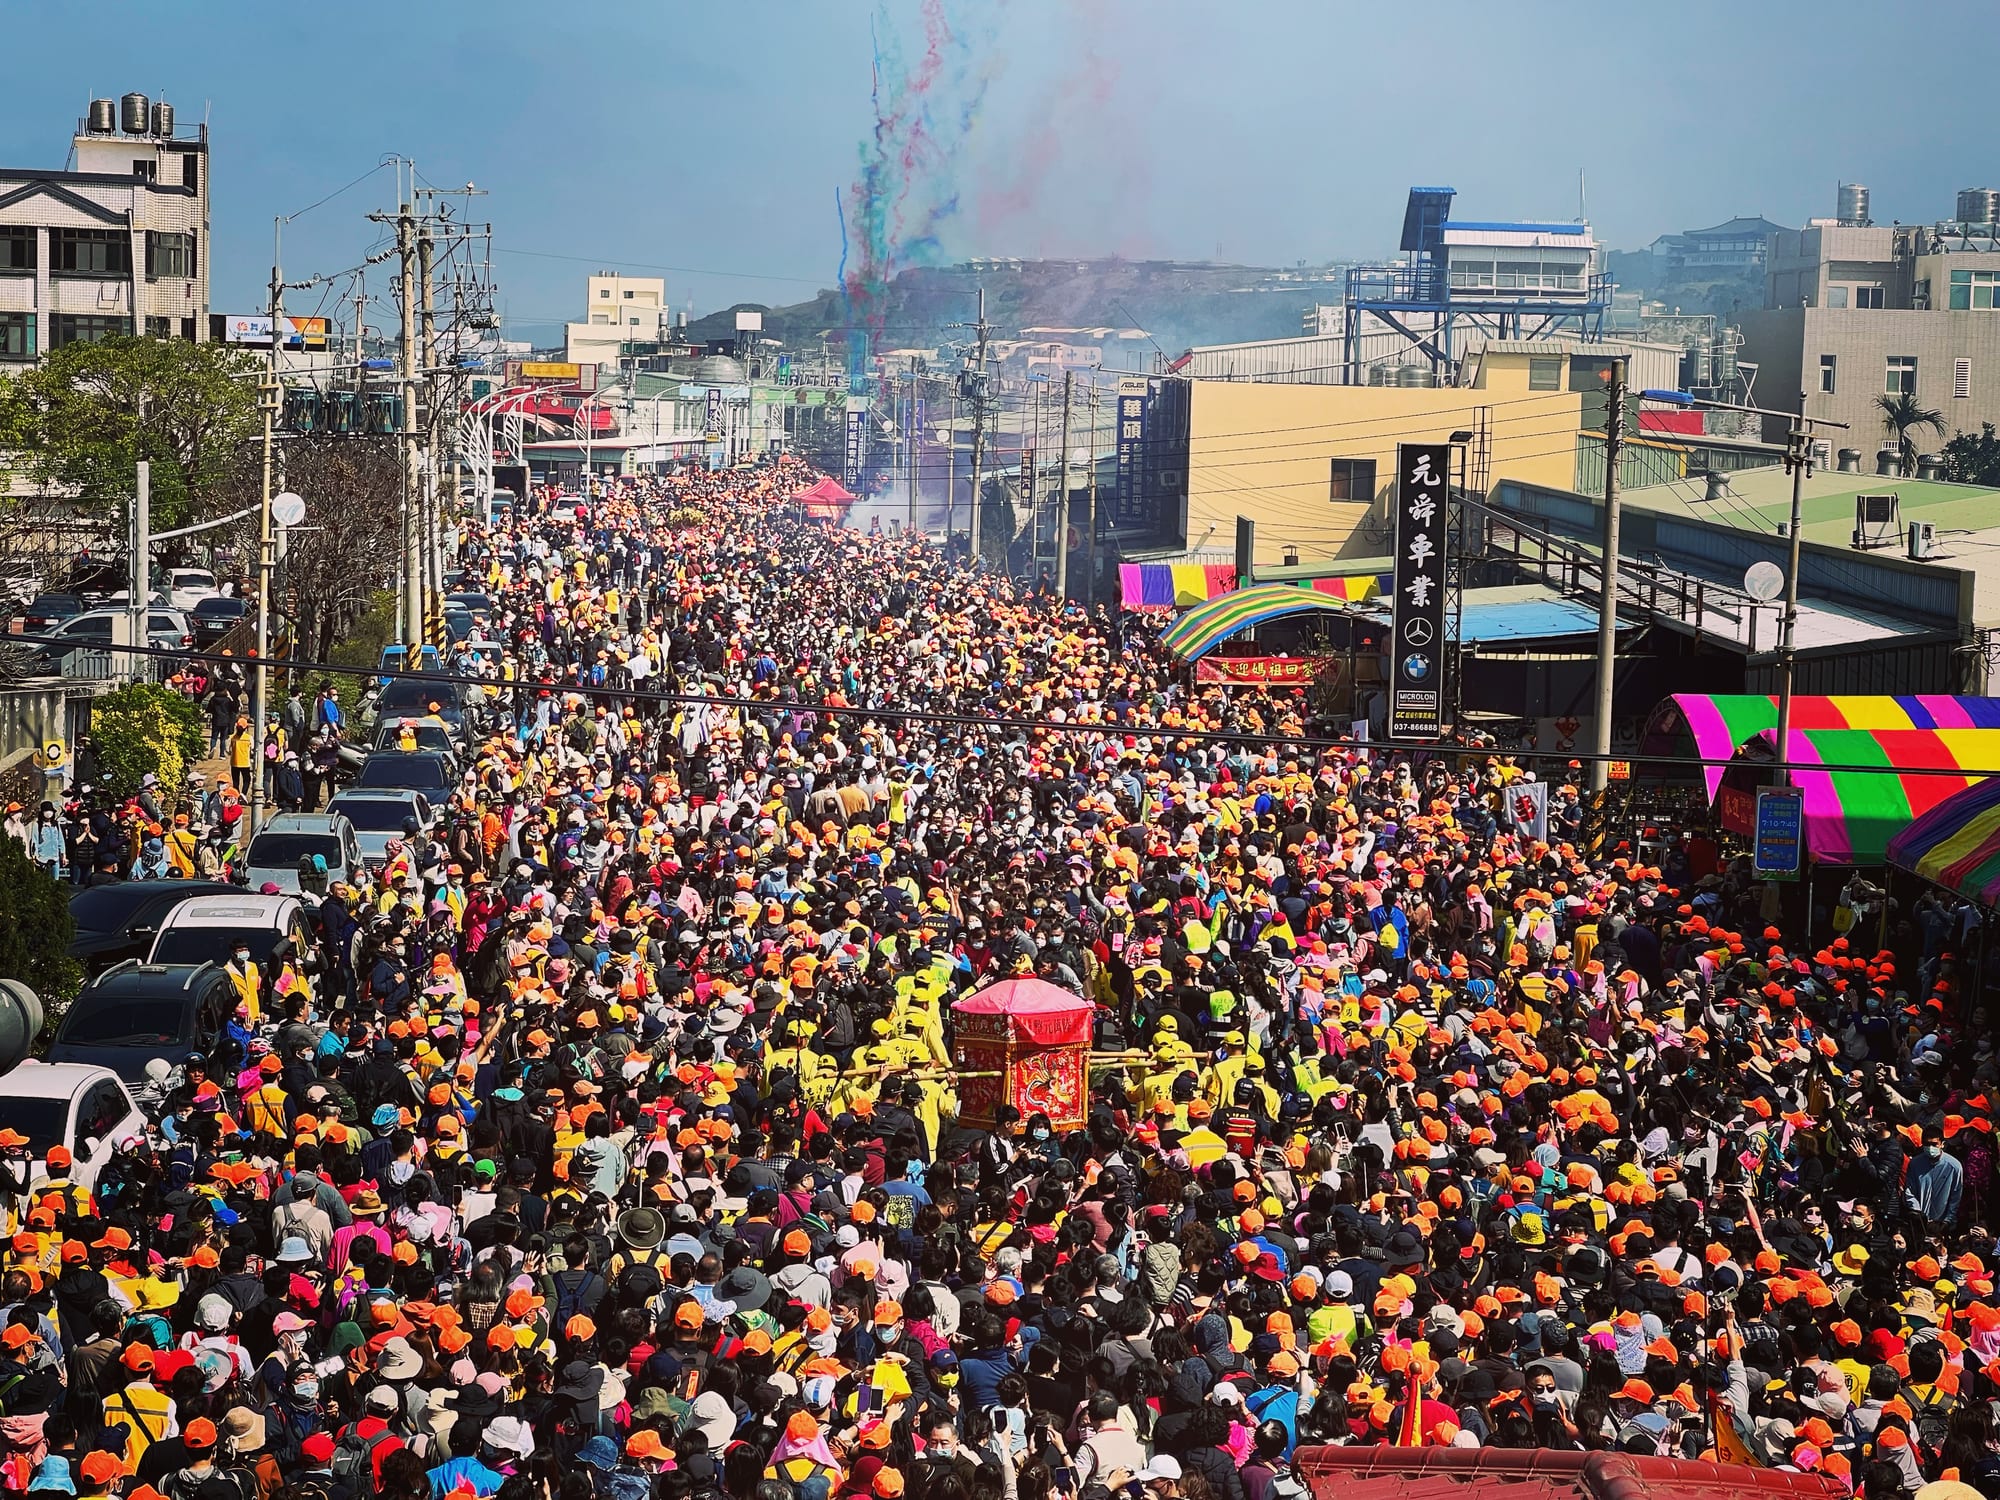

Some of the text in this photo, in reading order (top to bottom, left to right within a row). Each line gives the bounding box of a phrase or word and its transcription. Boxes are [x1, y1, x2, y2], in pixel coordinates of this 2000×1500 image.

[1123, 399, 1142, 439] 華碩
[1405, 454, 1441, 607] 元舜車業
[1406, 654, 1430, 664] BMW
[1400, 693, 1434, 701] MICROLON
